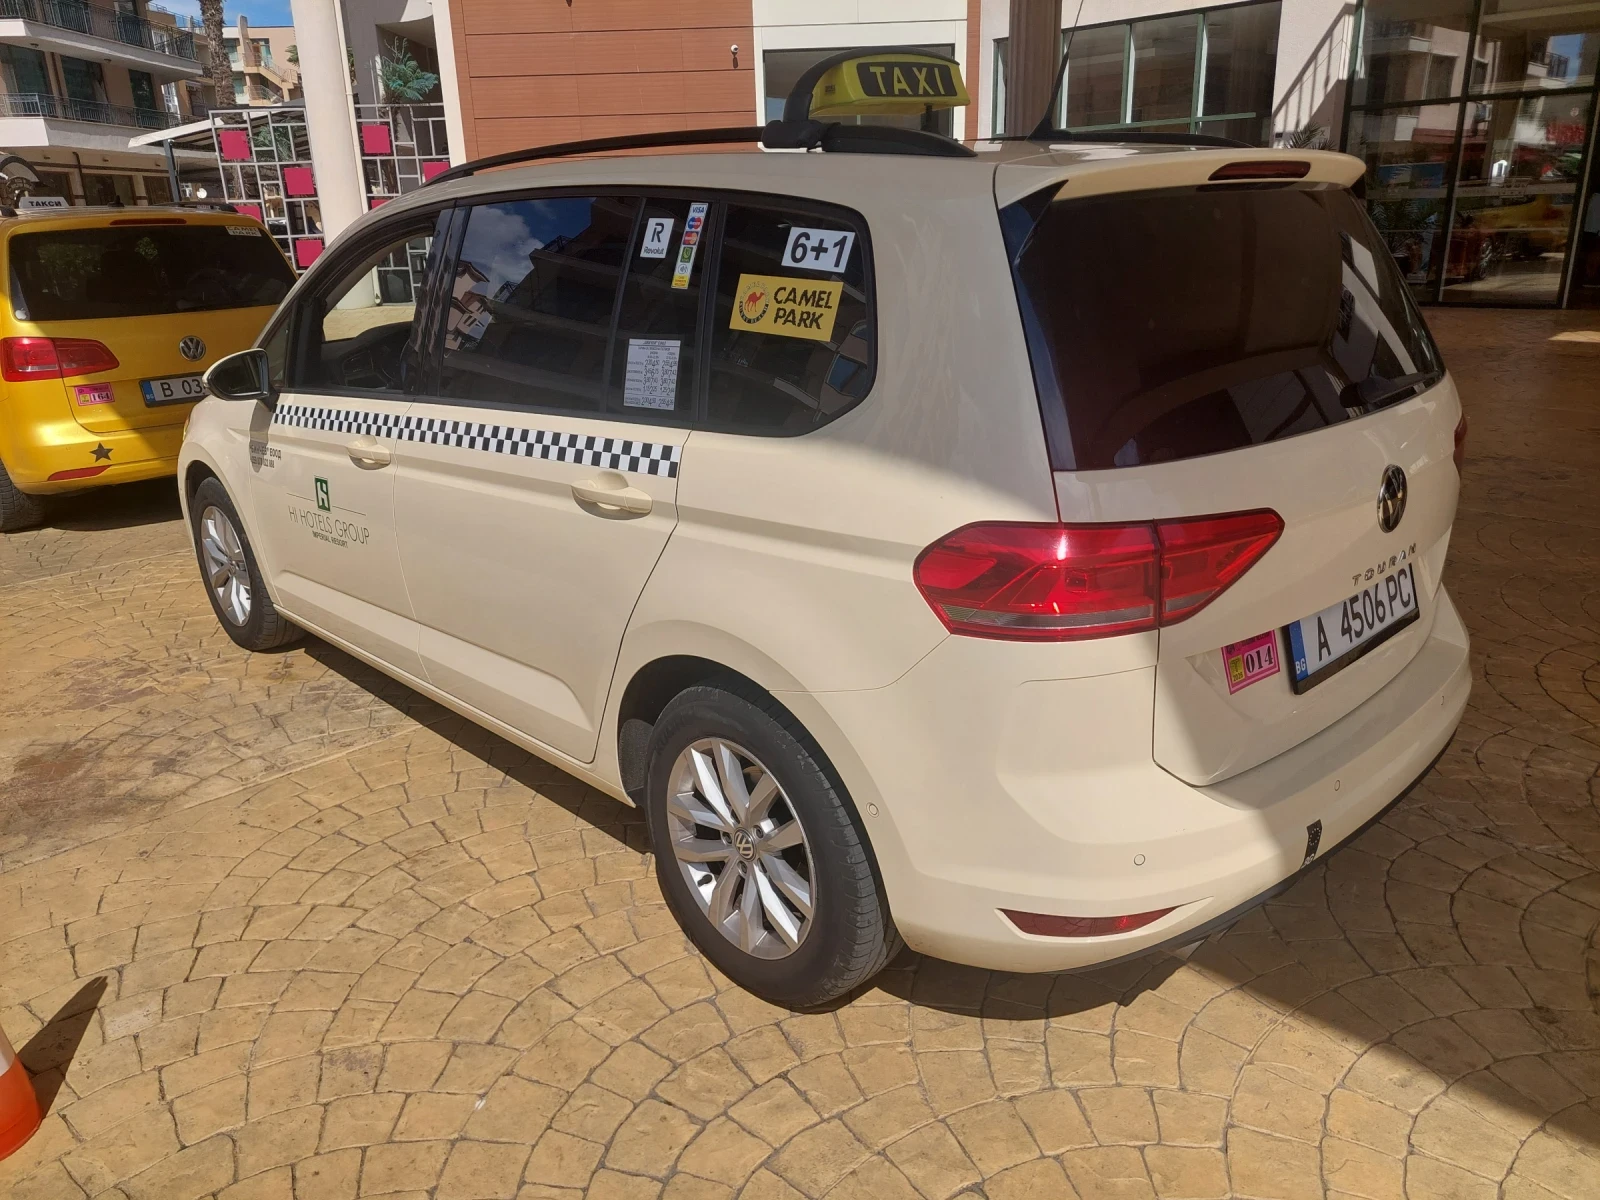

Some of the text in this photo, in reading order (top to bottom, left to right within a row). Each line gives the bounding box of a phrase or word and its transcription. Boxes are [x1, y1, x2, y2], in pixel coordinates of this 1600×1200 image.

[869, 66, 945, 95] TAXI
[644, 246, 664, 255] Revolut
[790, 231, 848, 268] 6+1
[774, 287, 832, 309] CAMEL
[774, 308, 823, 329] PARK
[160, 378, 206, 397] B 03
[288, 505, 370, 545] HI HOTELS GROUP
[1352, 542, 1416, 587] TOURAN
[1316, 615, 1332, 663] A
[1341, 582, 1387, 644] 4506
[1385, 567, 1411, 617] PC
[1245, 645, 1274, 674] 014
[1295, 657, 1307, 675] BG
